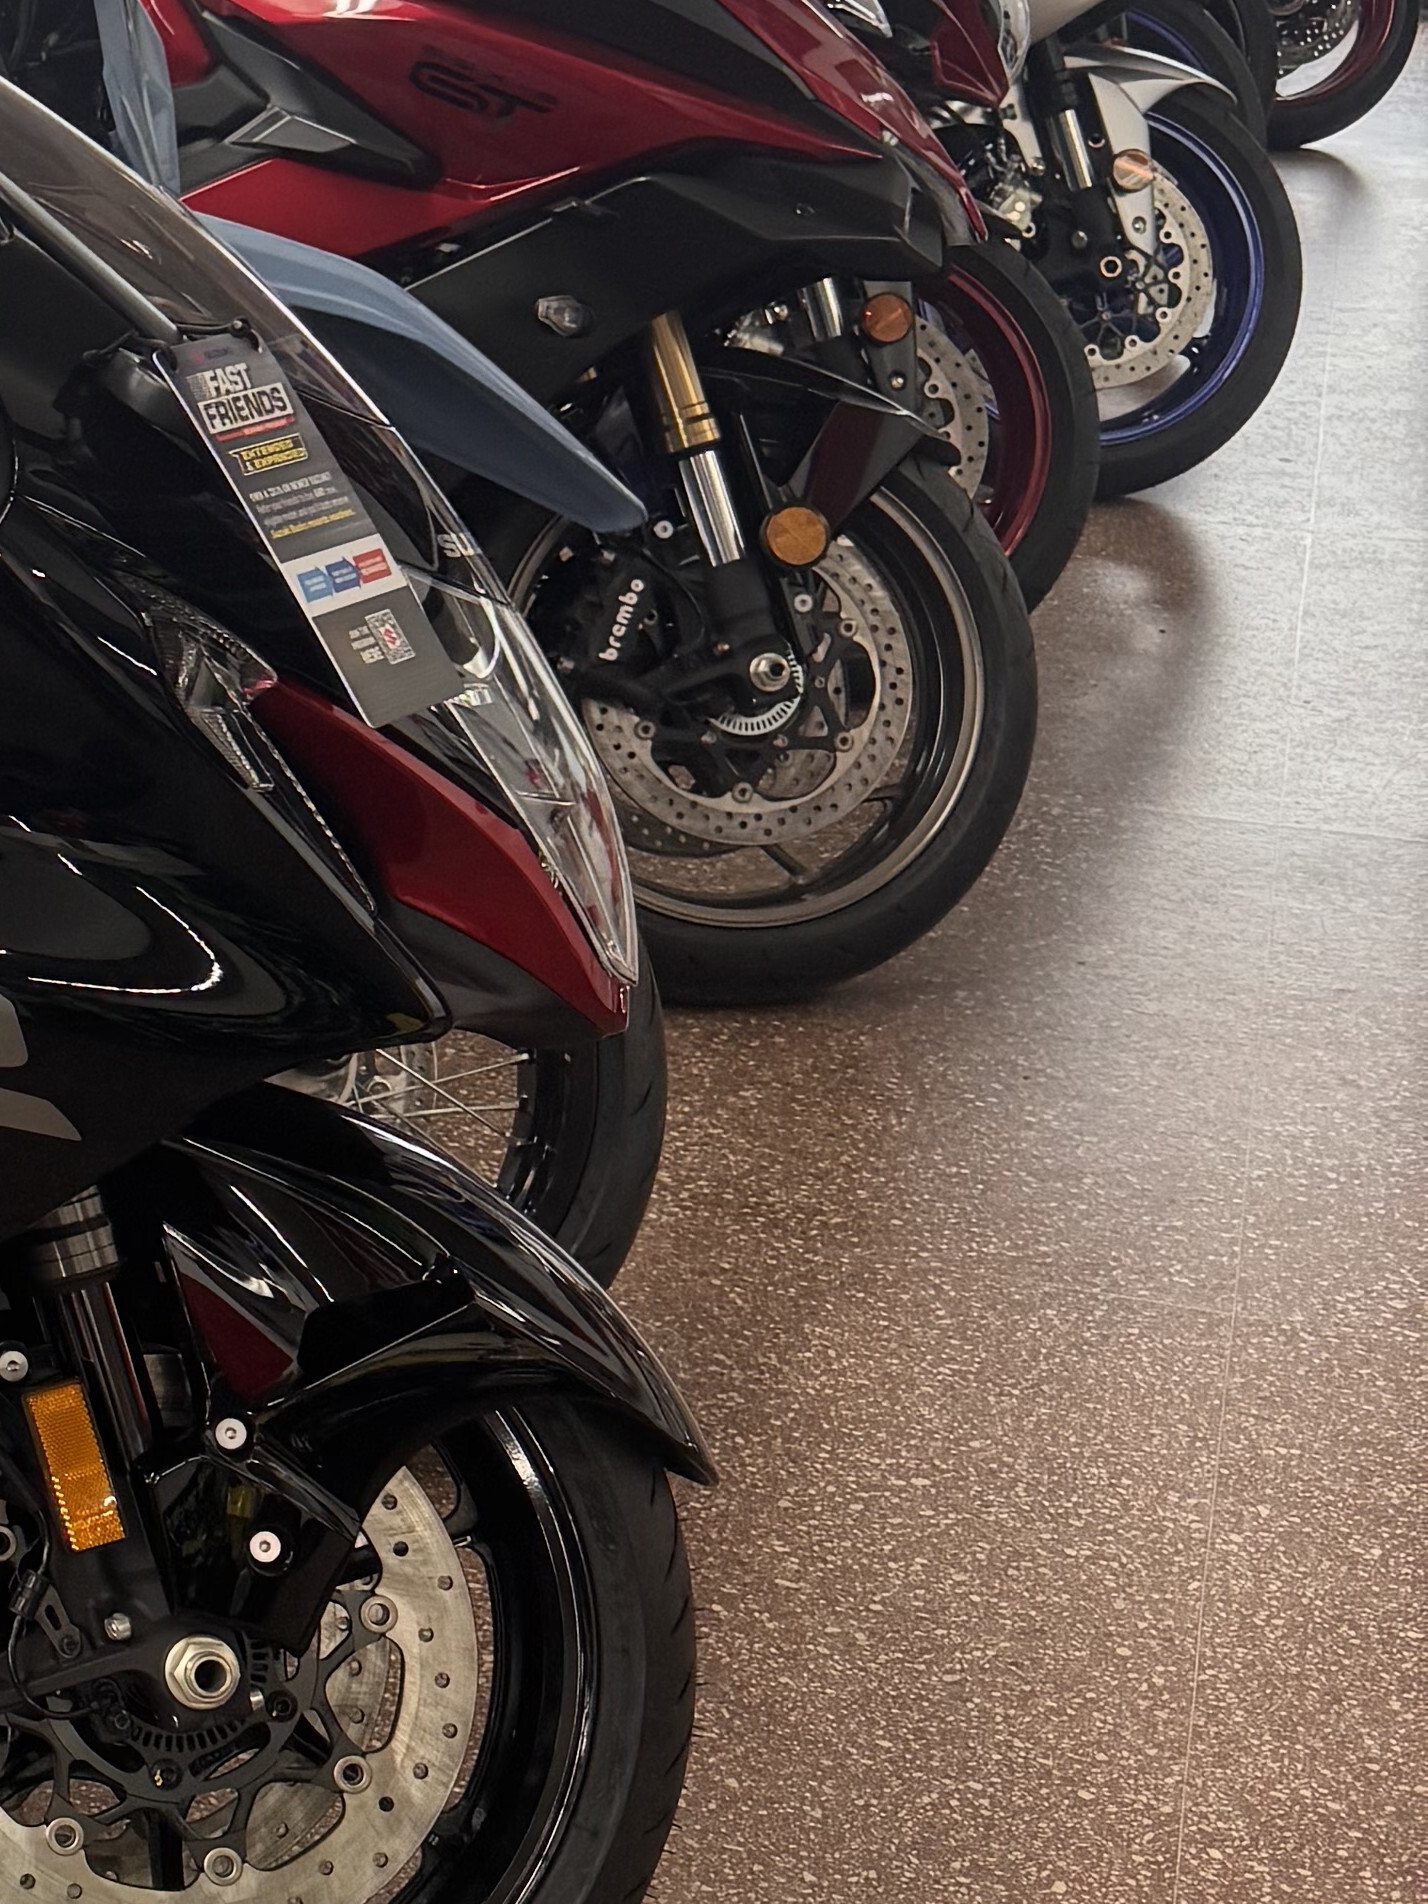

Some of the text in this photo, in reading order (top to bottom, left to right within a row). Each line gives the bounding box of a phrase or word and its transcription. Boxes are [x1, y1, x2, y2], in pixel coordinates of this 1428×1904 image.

[204, 362, 253, 398] FAST
[202, 386, 288, 430] FRIENDS
[598, 578, 646, 663] brembo
